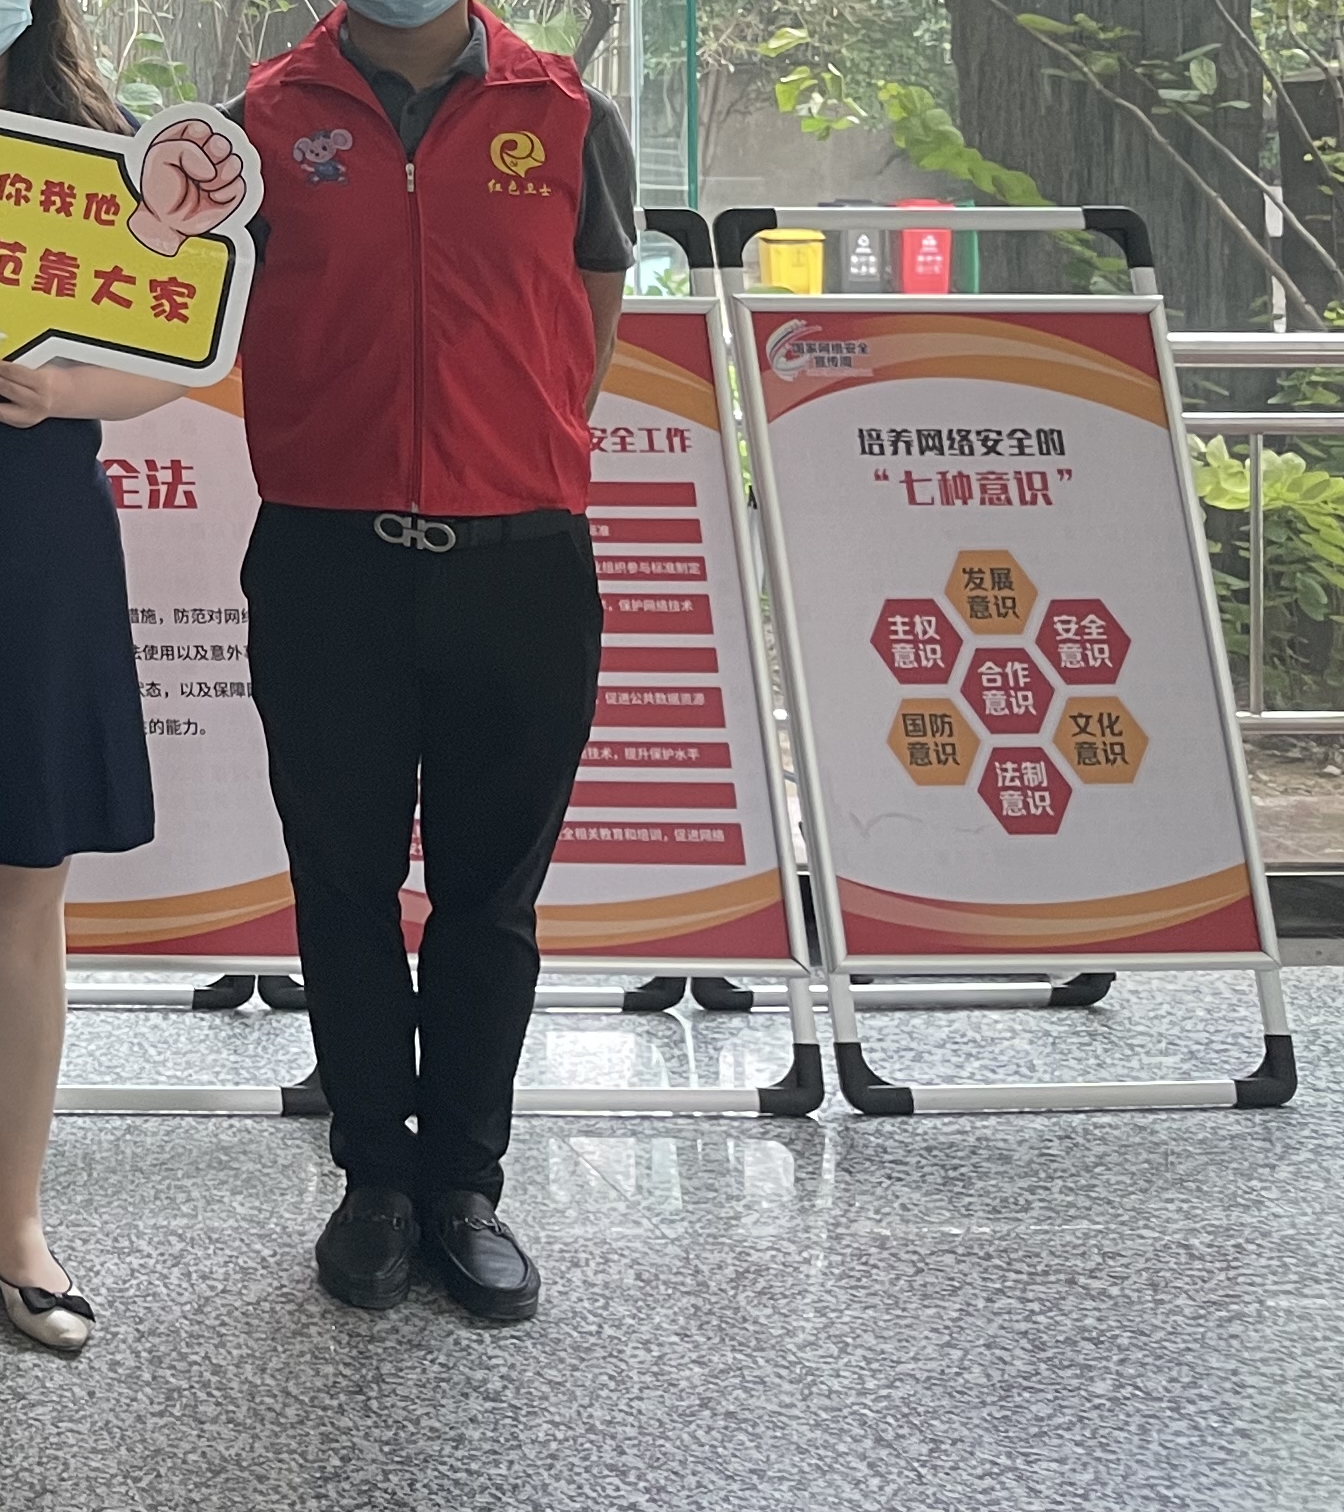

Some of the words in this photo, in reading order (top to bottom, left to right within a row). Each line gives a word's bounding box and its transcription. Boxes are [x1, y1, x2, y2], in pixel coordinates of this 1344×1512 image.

[487, 179, 552, 197] 红色卫士
[791, 341, 869, 355] 国家网络安全
[813, 356, 853, 368] 宣传周
[588, 426, 693, 453] 安全工作
[857, 427, 1066, 456] 培养网络安全的
[101, 458, 199, 510] 全法
[962, 567, 1015, 592] 发展
[967, 595, 1020, 620] 意识
[887, 614, 941, 641] 主权
[1053, 614, 1108, 641] 安全
[891, 643, 945, 669] 意识
[1058, 643, 1113, 669] 意识
[977, 660, 1031, 688] 合作
[982, 690, 1037, 717] 意识
[144, 718, 209, 736] 的能力。
[901, 712, 954, 738] 国防
[1069, 712, 1124, 738] 文化
[907, 741, 961, 767] 意识
[1074, 741, 1129, 767] 意识
[994, 761, 1049, 788] 法制
[999, 790, 1055, 816] 意识
